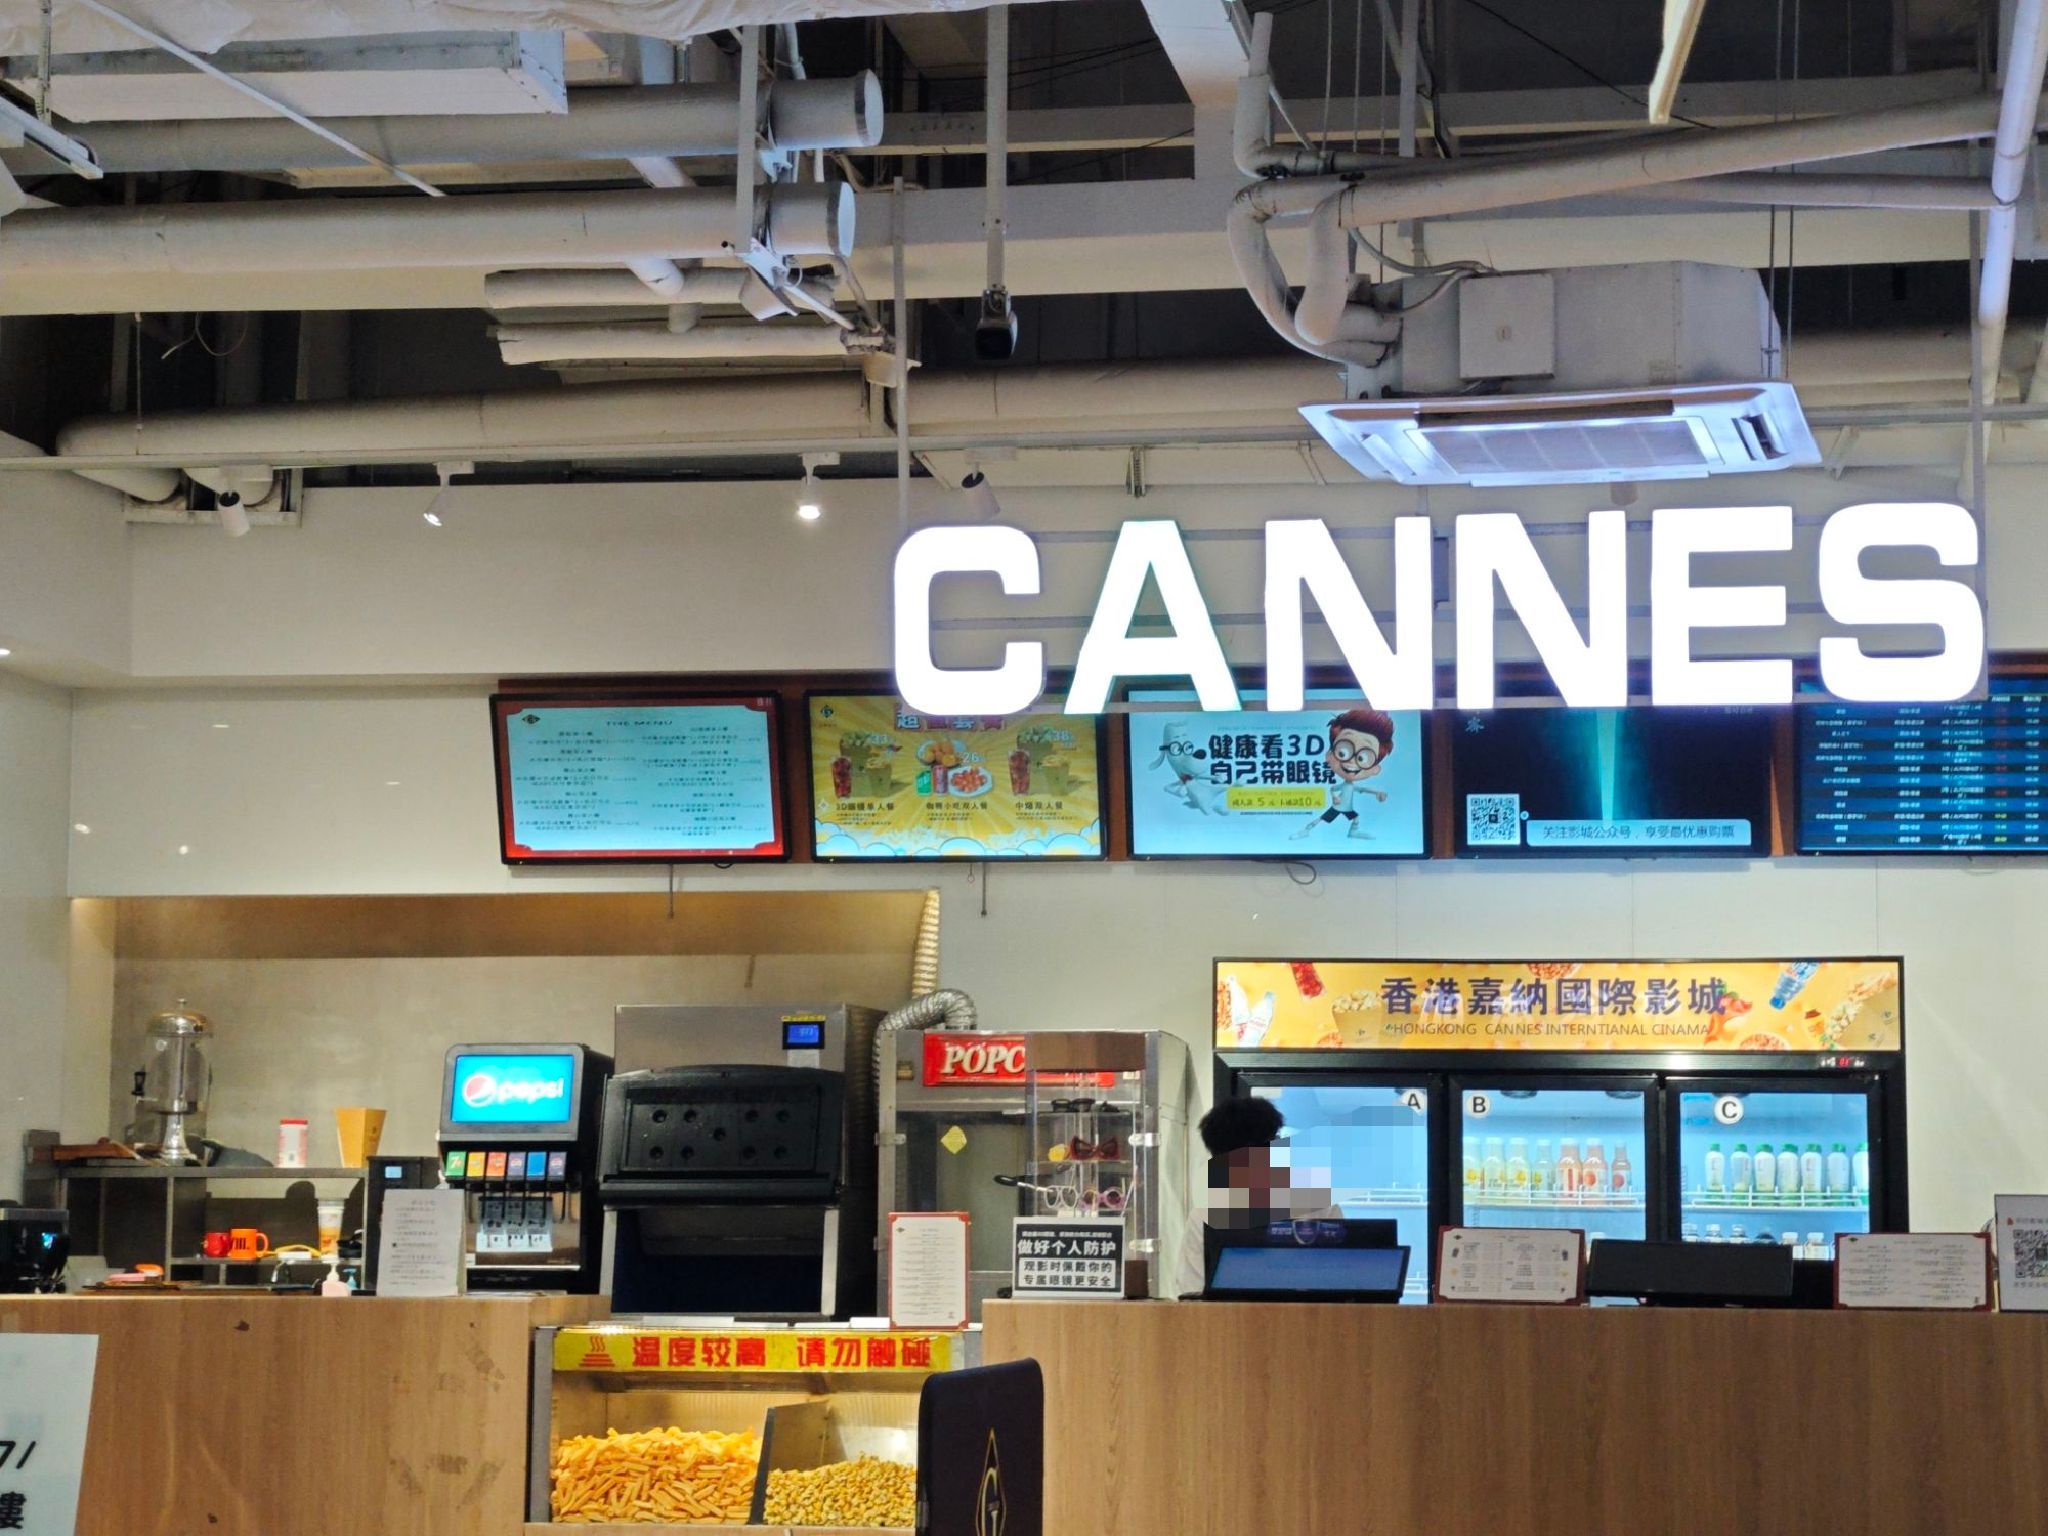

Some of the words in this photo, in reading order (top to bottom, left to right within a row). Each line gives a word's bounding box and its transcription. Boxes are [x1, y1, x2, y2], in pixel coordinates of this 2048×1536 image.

[892, 501, 1985, 716] CANNES
[1208, 733, 1325, 760] 健康看3D
[1209, 760, 1337, 785] 自己带眼镜
[1380, 977, 1726, 1017] 香港嘉納國際影城
[1393, 1023, 1477, 1036] HONGKONG
[1485, 1023, 1541, 1036] CANNES
[1651, 1022, 1711, 1036] CINAMA
[497, 1077, 565, 1104] pepsi
[1406, 1093, 1422, 1110] A
[1472, 1095, 1487, 1114] B
[1721, 1100, 1738, 1119] C
[1017, 1239, 1117, 1256] 做好个人防护
[1023, 1260, 1113, 1273] 观影时佩戴你的
[632, 1336, 767, 1368] 温度较高
[796, 1336, 932, 1368] 请勿触碰
